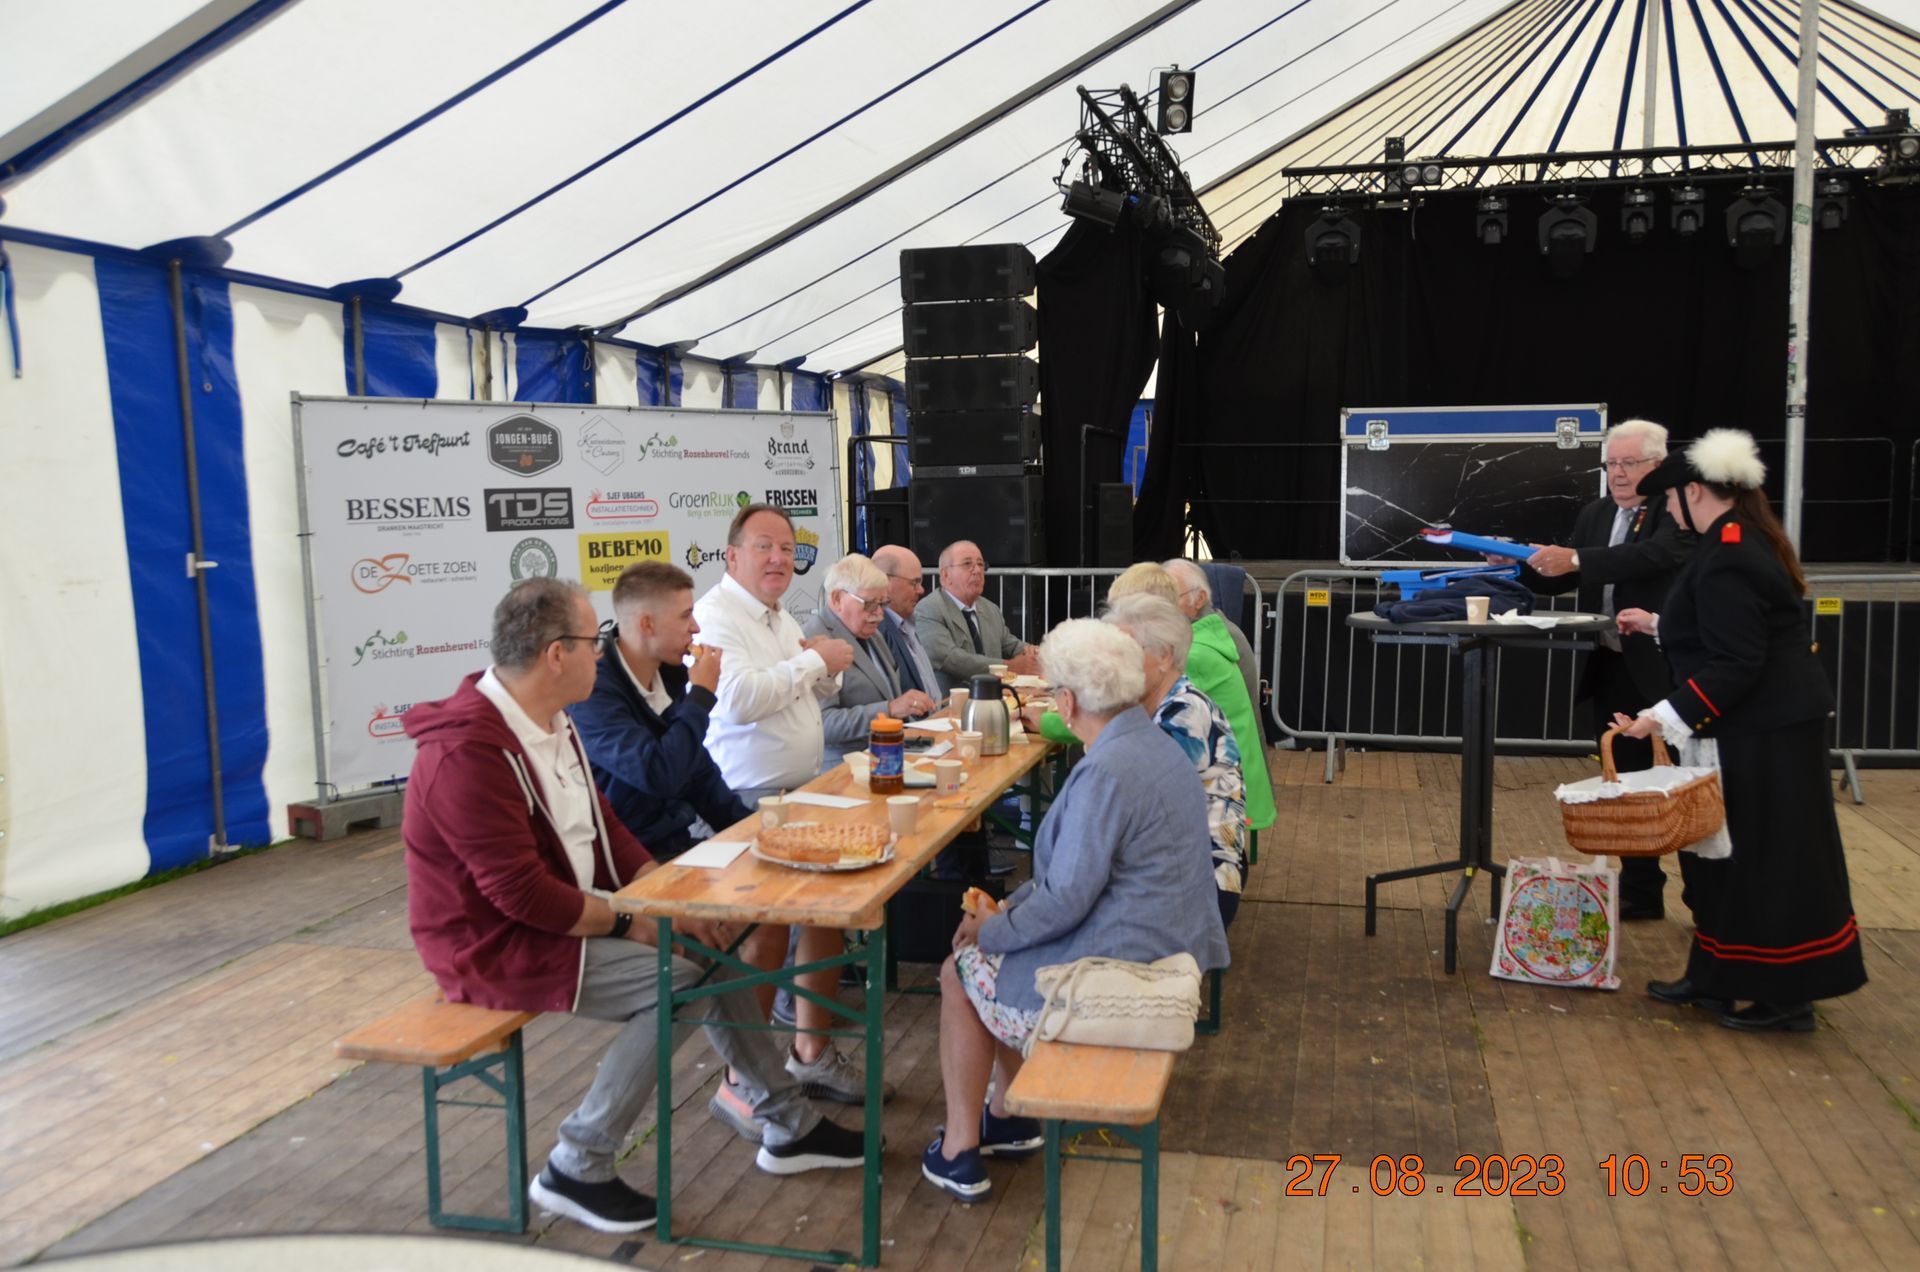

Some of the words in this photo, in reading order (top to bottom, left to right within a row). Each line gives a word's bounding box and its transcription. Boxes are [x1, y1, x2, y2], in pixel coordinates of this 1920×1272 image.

[337, 437, 386, 458] Café
[403, 431, 470, 456] Trefpunt
[651, 448, 682, 460] Stichting
[683, 449, 729, 459] Rozenheuvel
[730, 449, 750, 459] Fonds
[768, 437, 809, 456] Brand
[488, 492, 568, 518] TDS
[606, 491, 620, 500] SJEF
[765, 489, 817, 506] FRISSEN
[346, 496, 471, 520] BESSEMS
[500, 517, 569, 527] PRODUCTIONS
[588, 538, 662, 559] BEBEMO
[360, 566, 378, 579] DE
[443, 560, 476, 574] ZOEN
[372, 649, 414, 660] Stichting
[416, 640, 478, 655] Rozenheuvel
